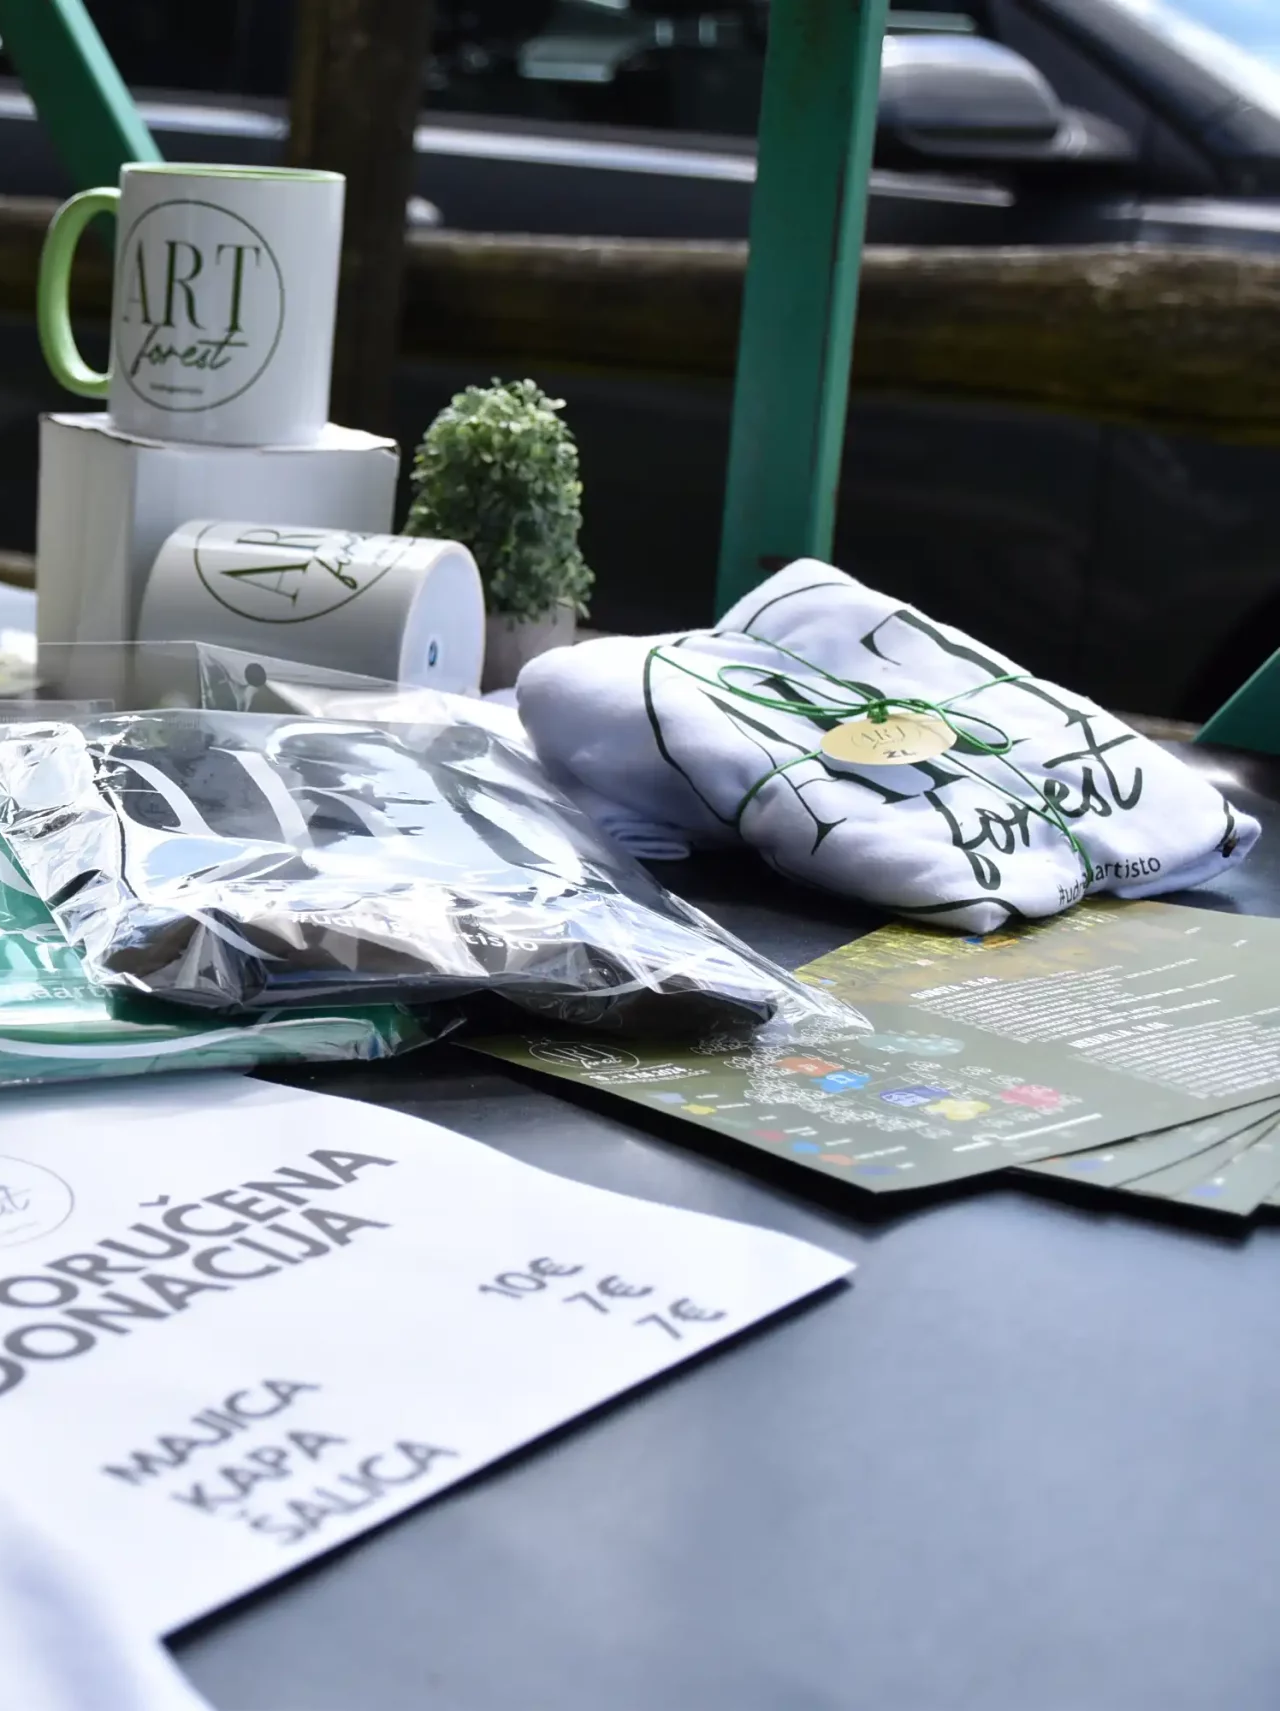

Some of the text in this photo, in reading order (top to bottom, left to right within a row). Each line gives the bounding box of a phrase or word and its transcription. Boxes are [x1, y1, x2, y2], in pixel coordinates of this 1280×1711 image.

[122, 240, 261, 332] ART
[130, 324, 248, 379] forest
[923, 716, 1143, 890] forest
[101, 1256, 585, 1485] MAJICA 10€
[169, 1429, 349, 1515] KAPA
[235, 1439, 460, 1546] ŠALICA
